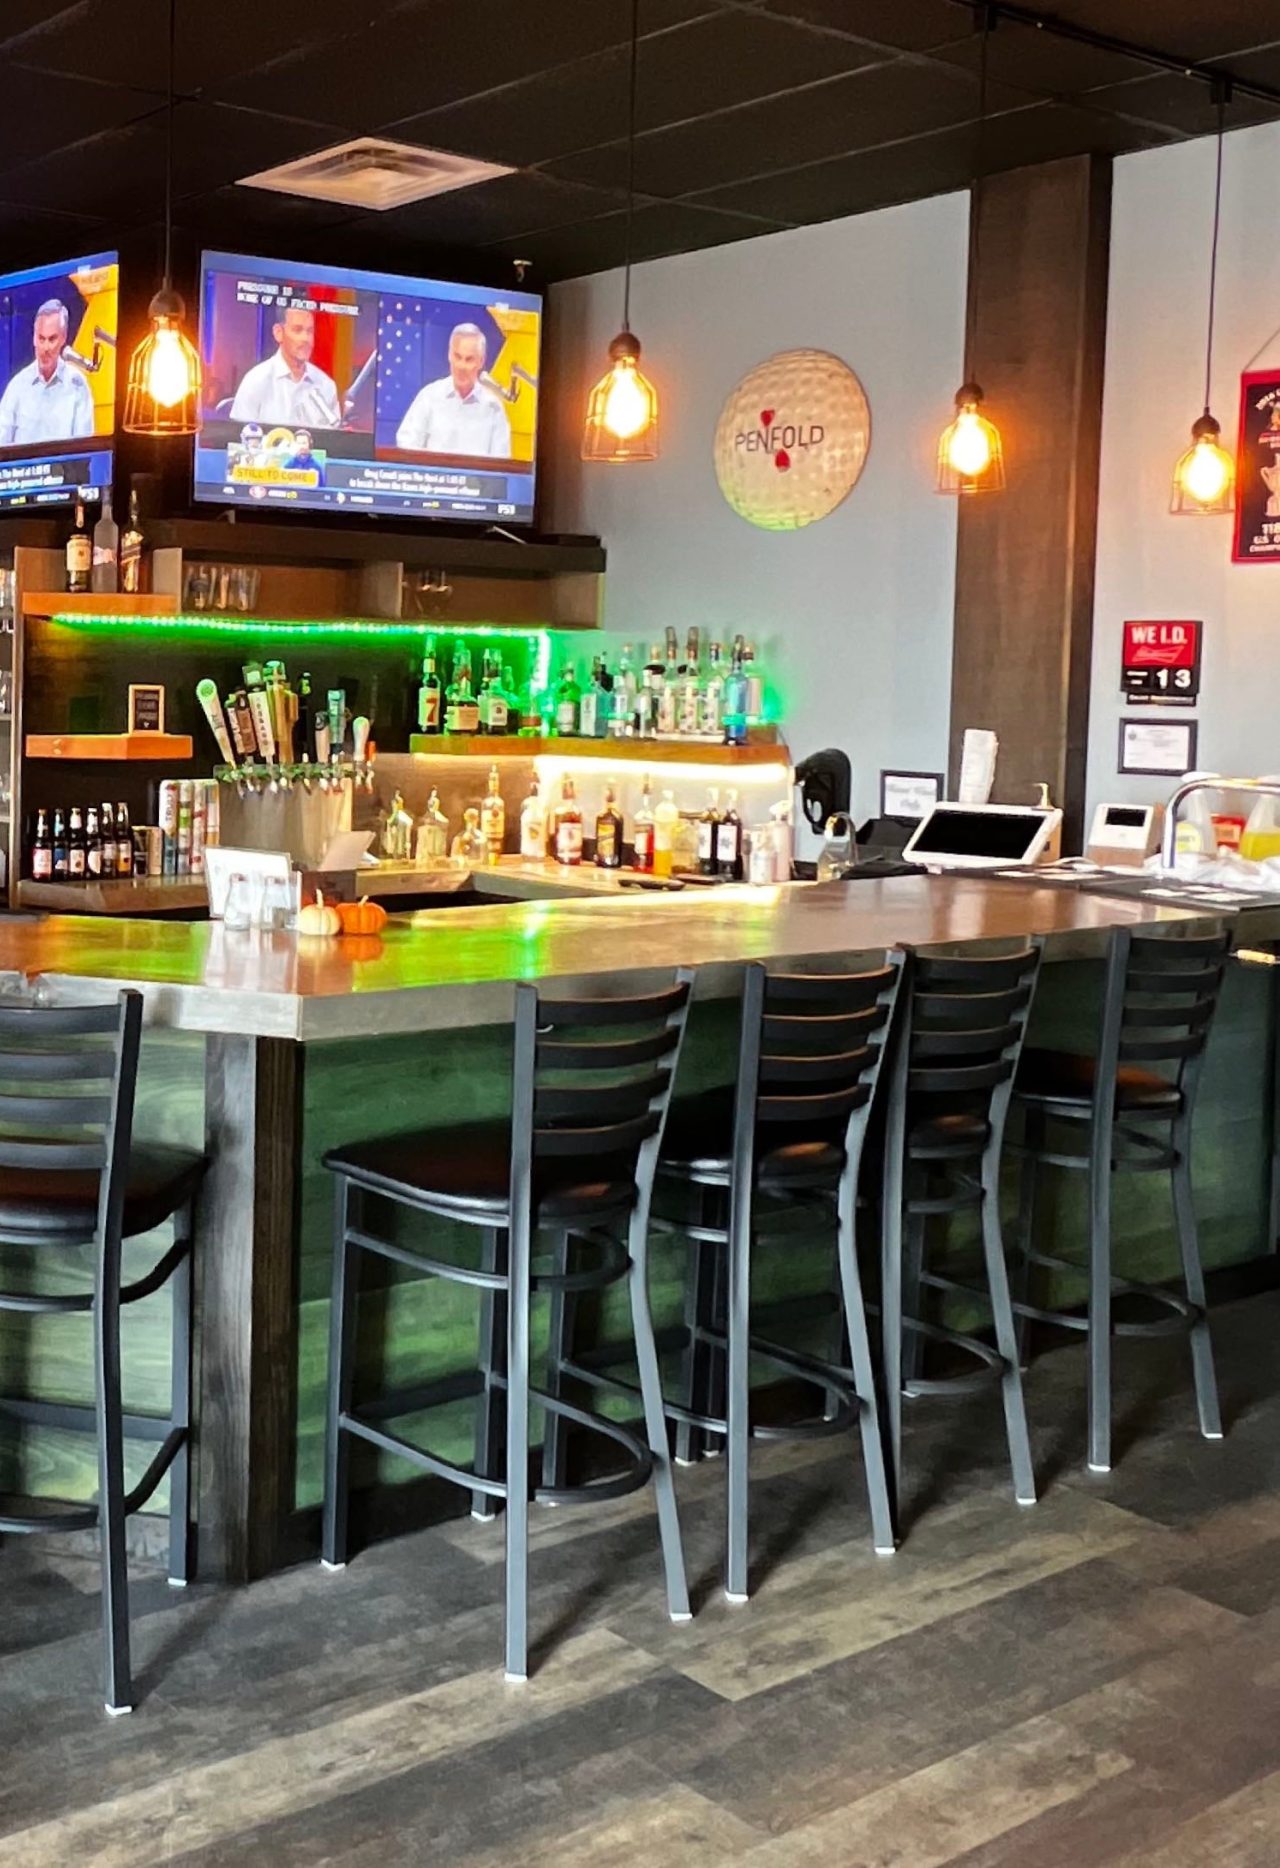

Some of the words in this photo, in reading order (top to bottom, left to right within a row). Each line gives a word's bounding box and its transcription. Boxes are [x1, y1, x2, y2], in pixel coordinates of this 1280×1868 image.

[735, 425, 824, 454] PENFOLD
[236, 469, 263, 479] STILL
[267, 470, 280, 480] TO
[1131, 625, 1158, 644] WE
[426, 697, 438, 723] 7
